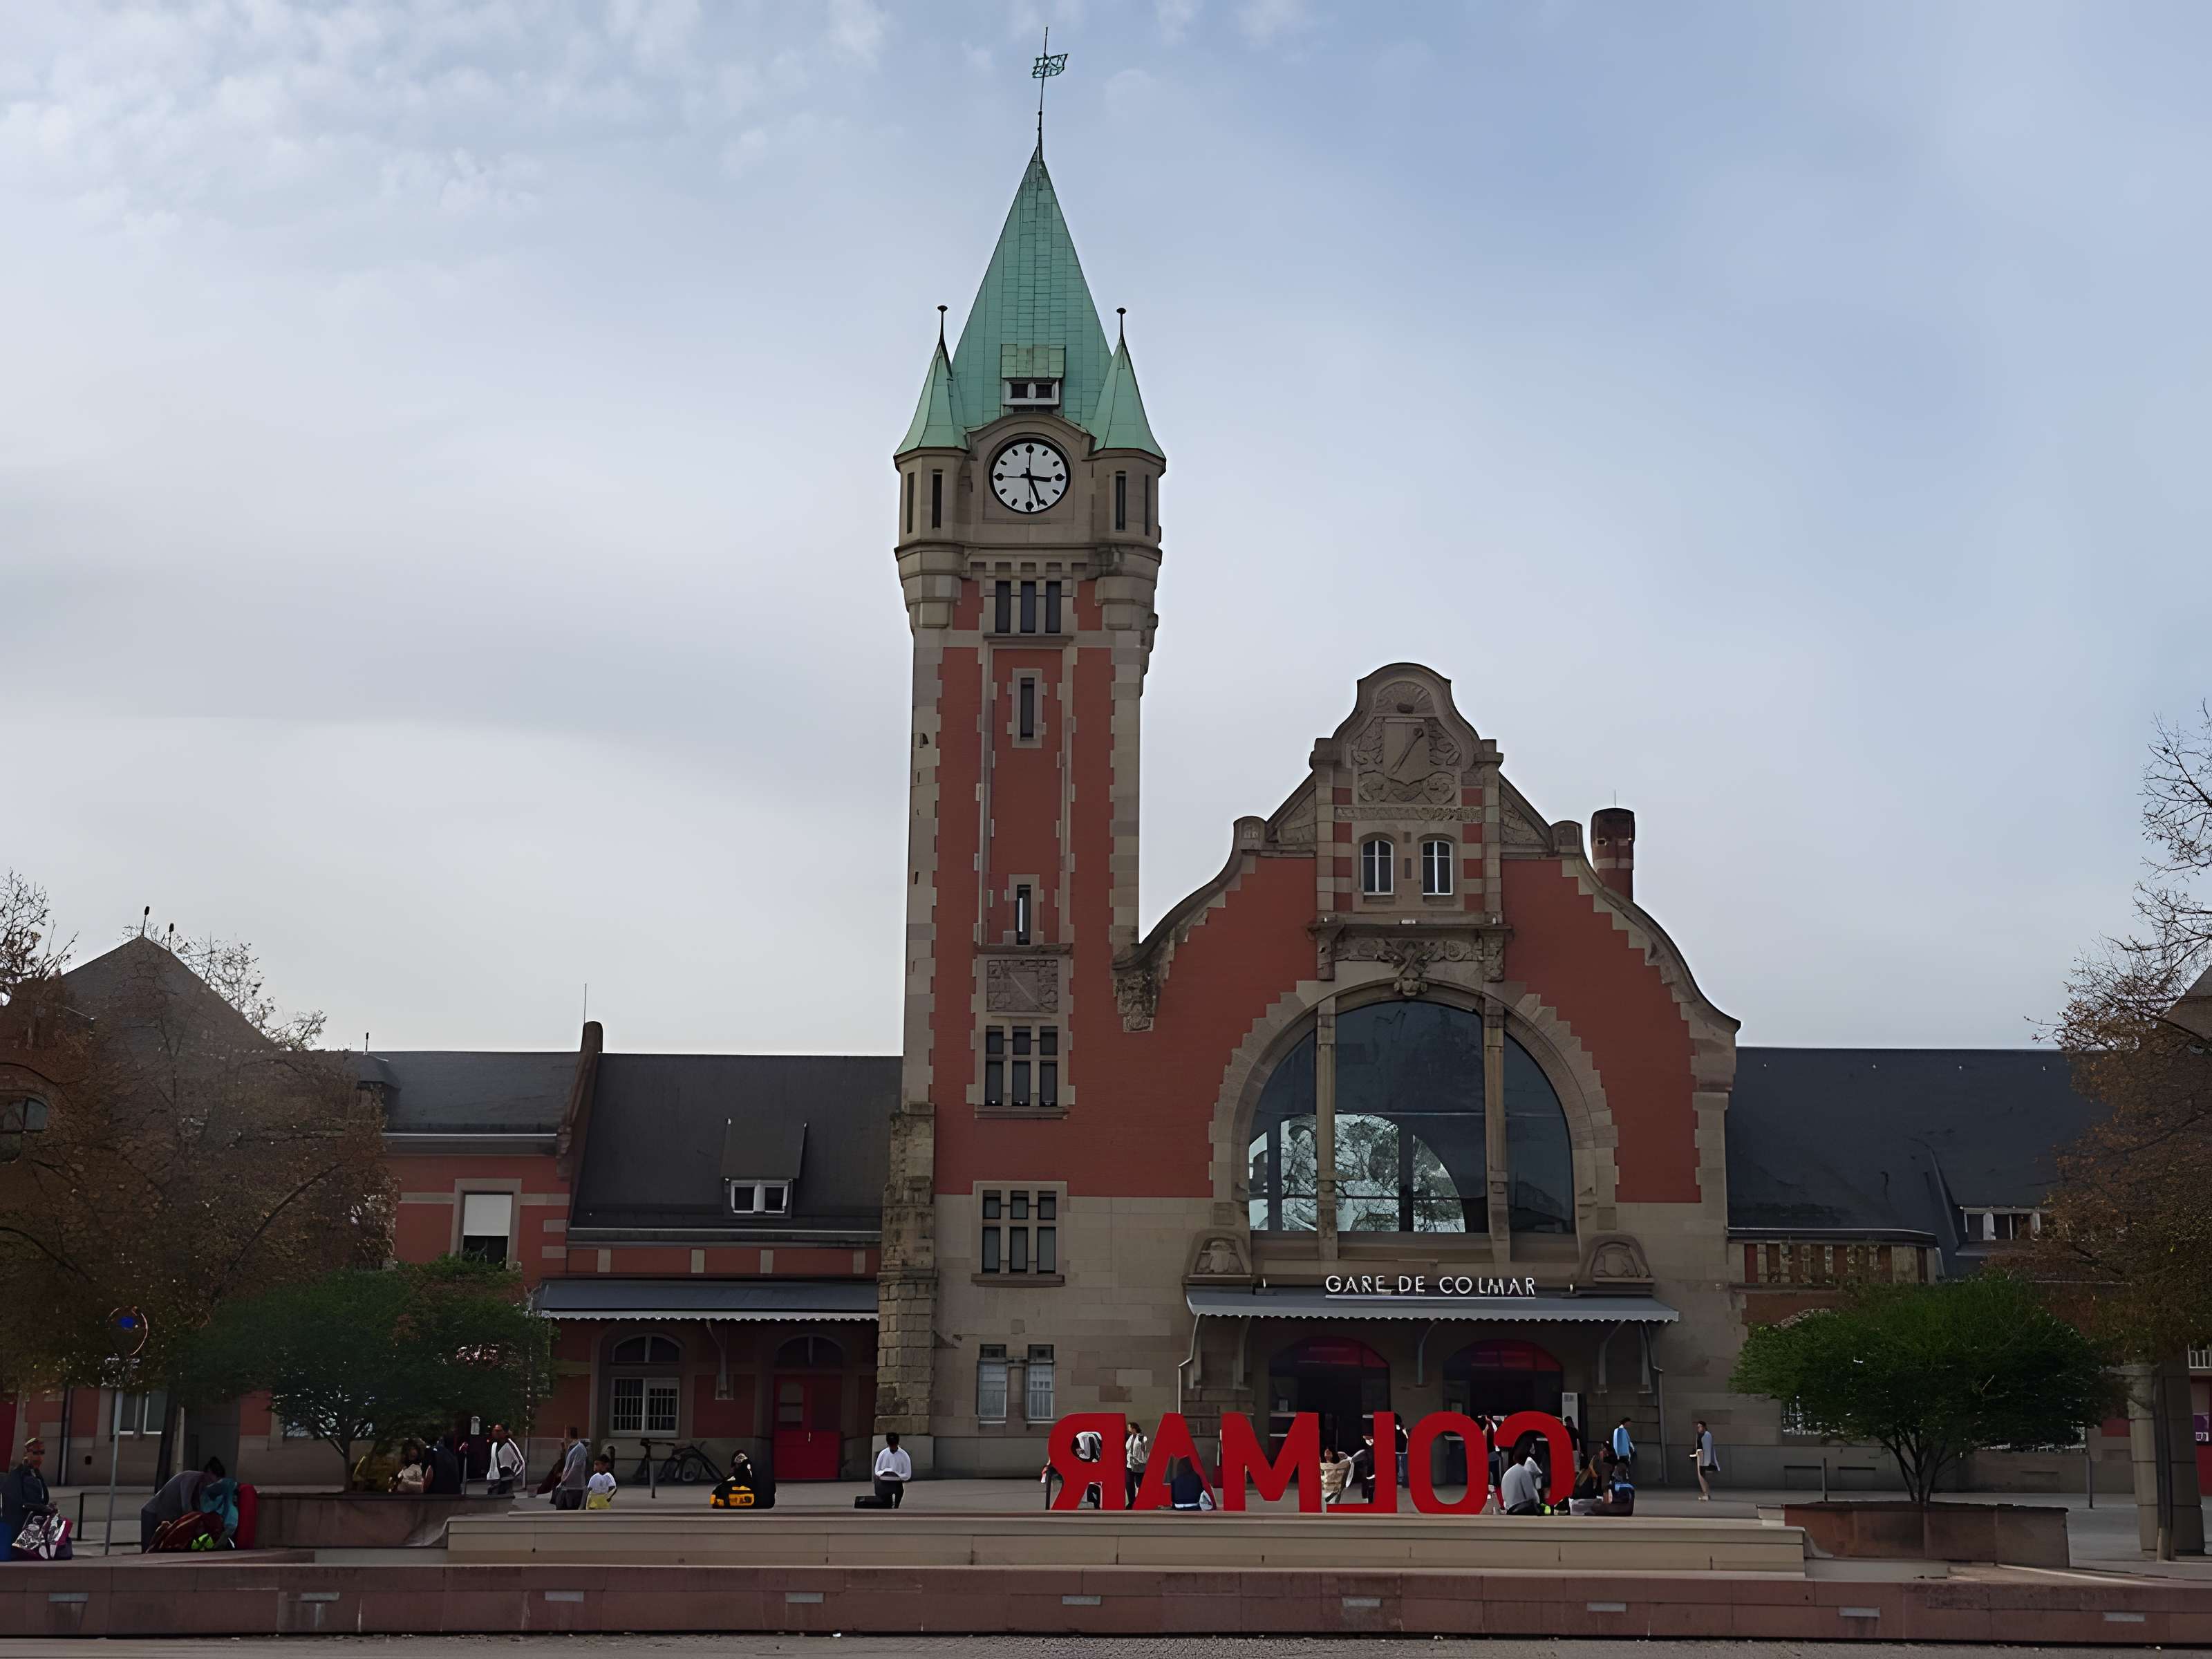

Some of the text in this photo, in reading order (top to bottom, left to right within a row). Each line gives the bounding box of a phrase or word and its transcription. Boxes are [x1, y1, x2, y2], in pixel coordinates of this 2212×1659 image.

[1325, 1275, 1535, 1295] GARE DE COLMAR
